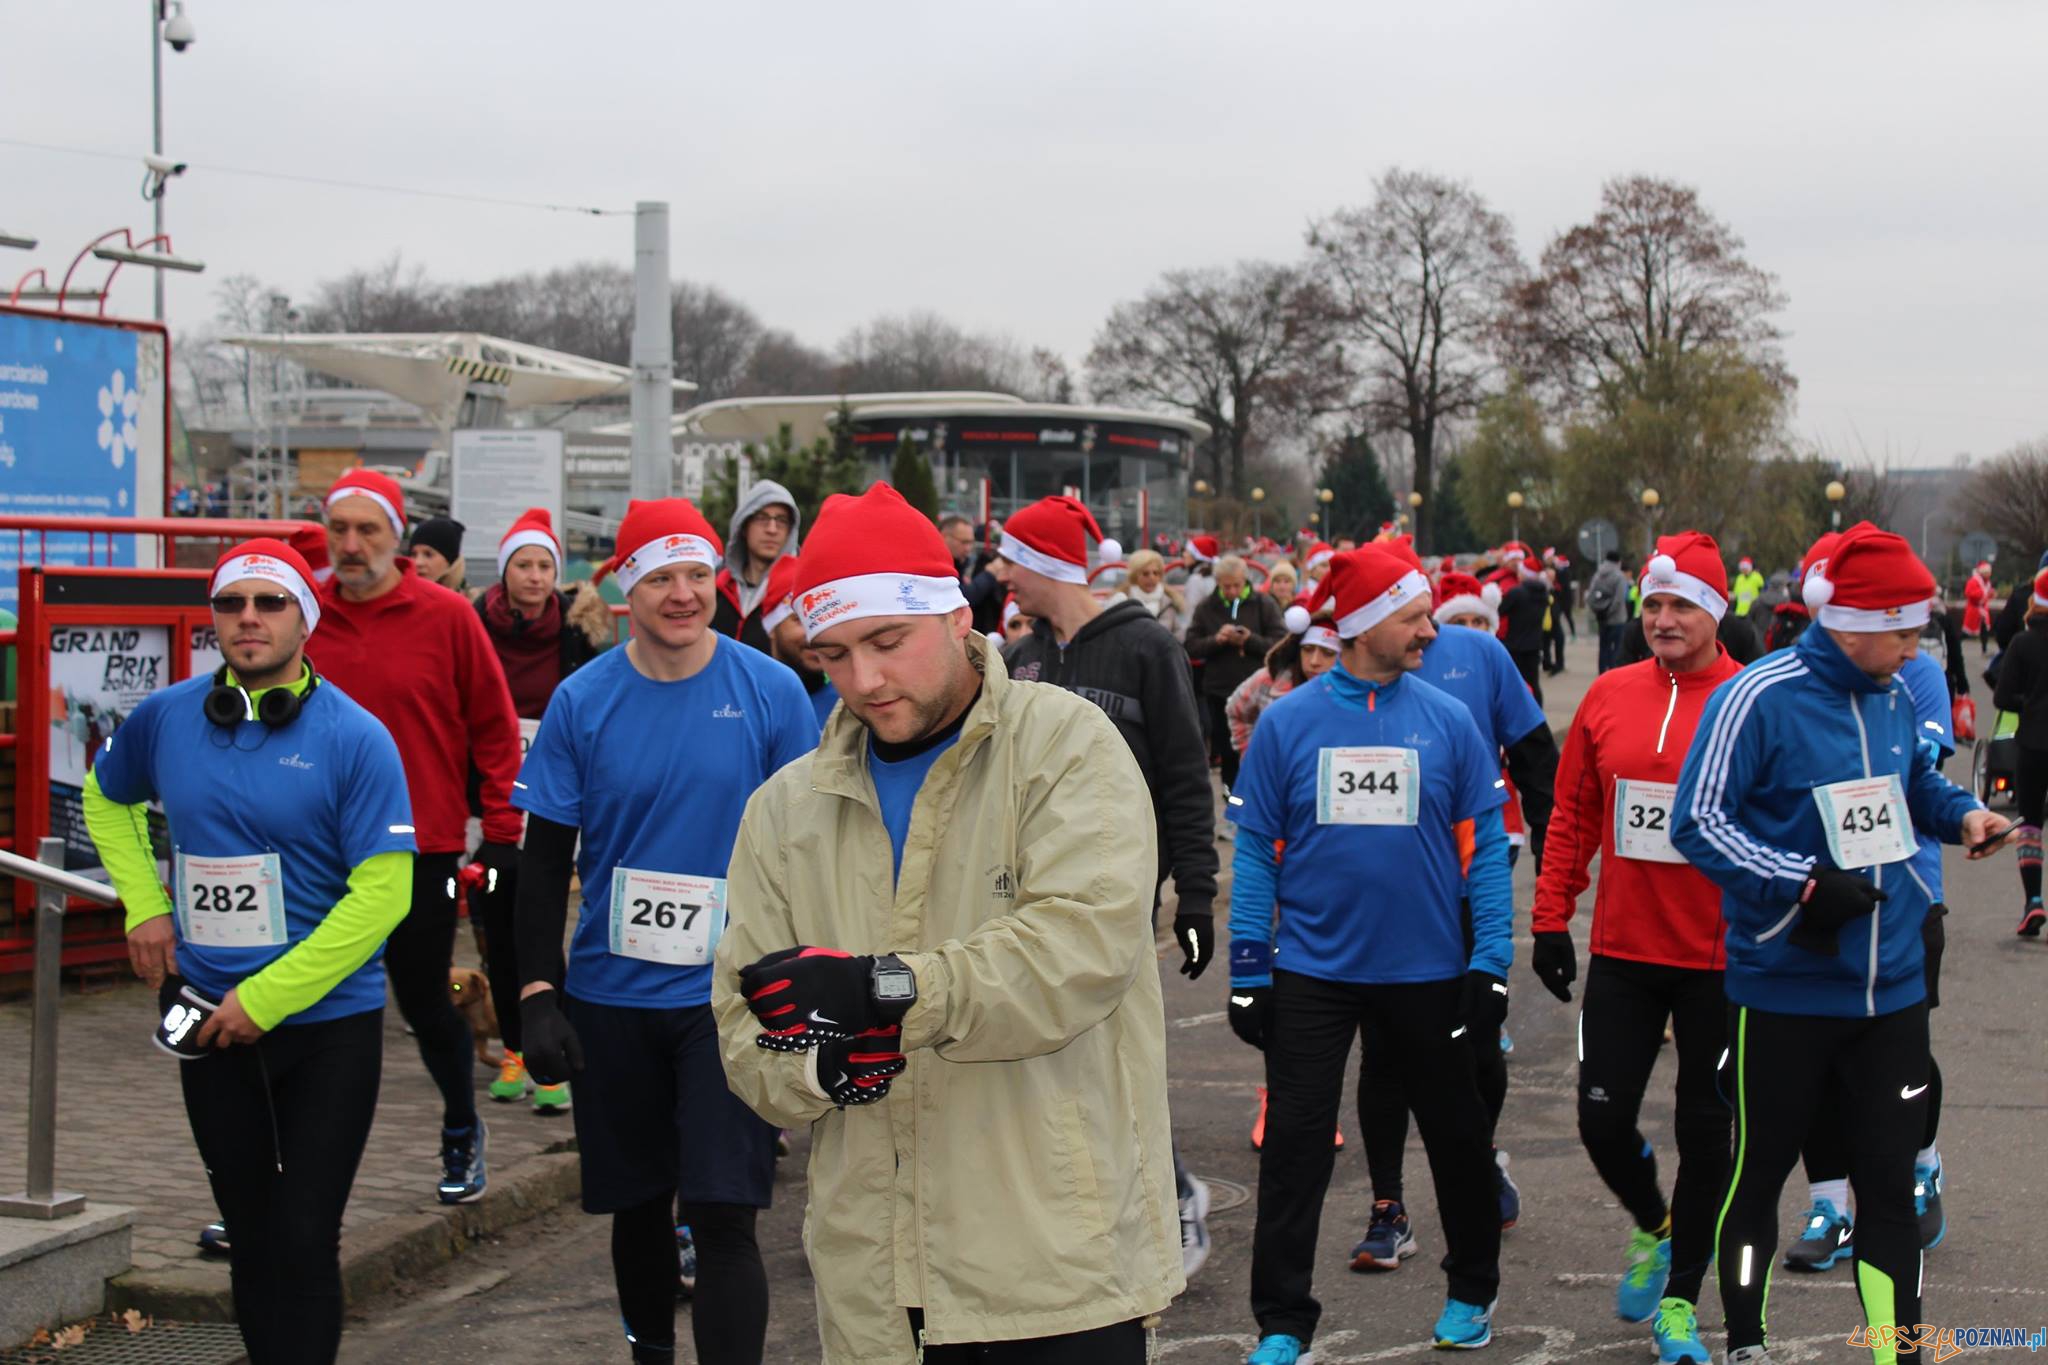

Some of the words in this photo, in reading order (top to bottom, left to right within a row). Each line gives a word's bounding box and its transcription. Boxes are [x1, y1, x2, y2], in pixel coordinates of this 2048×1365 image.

[51, 628, 140, 653] GRAND
[104, 654, 163, 678] PRIX
[1337, 770, 1399, 795] 344
[1628, 804, 1672, 831] 32
[1842, 803, 1891, 834] 434
[192, 883, 259, 913] 282
[629, 898, 703, 931] 267
